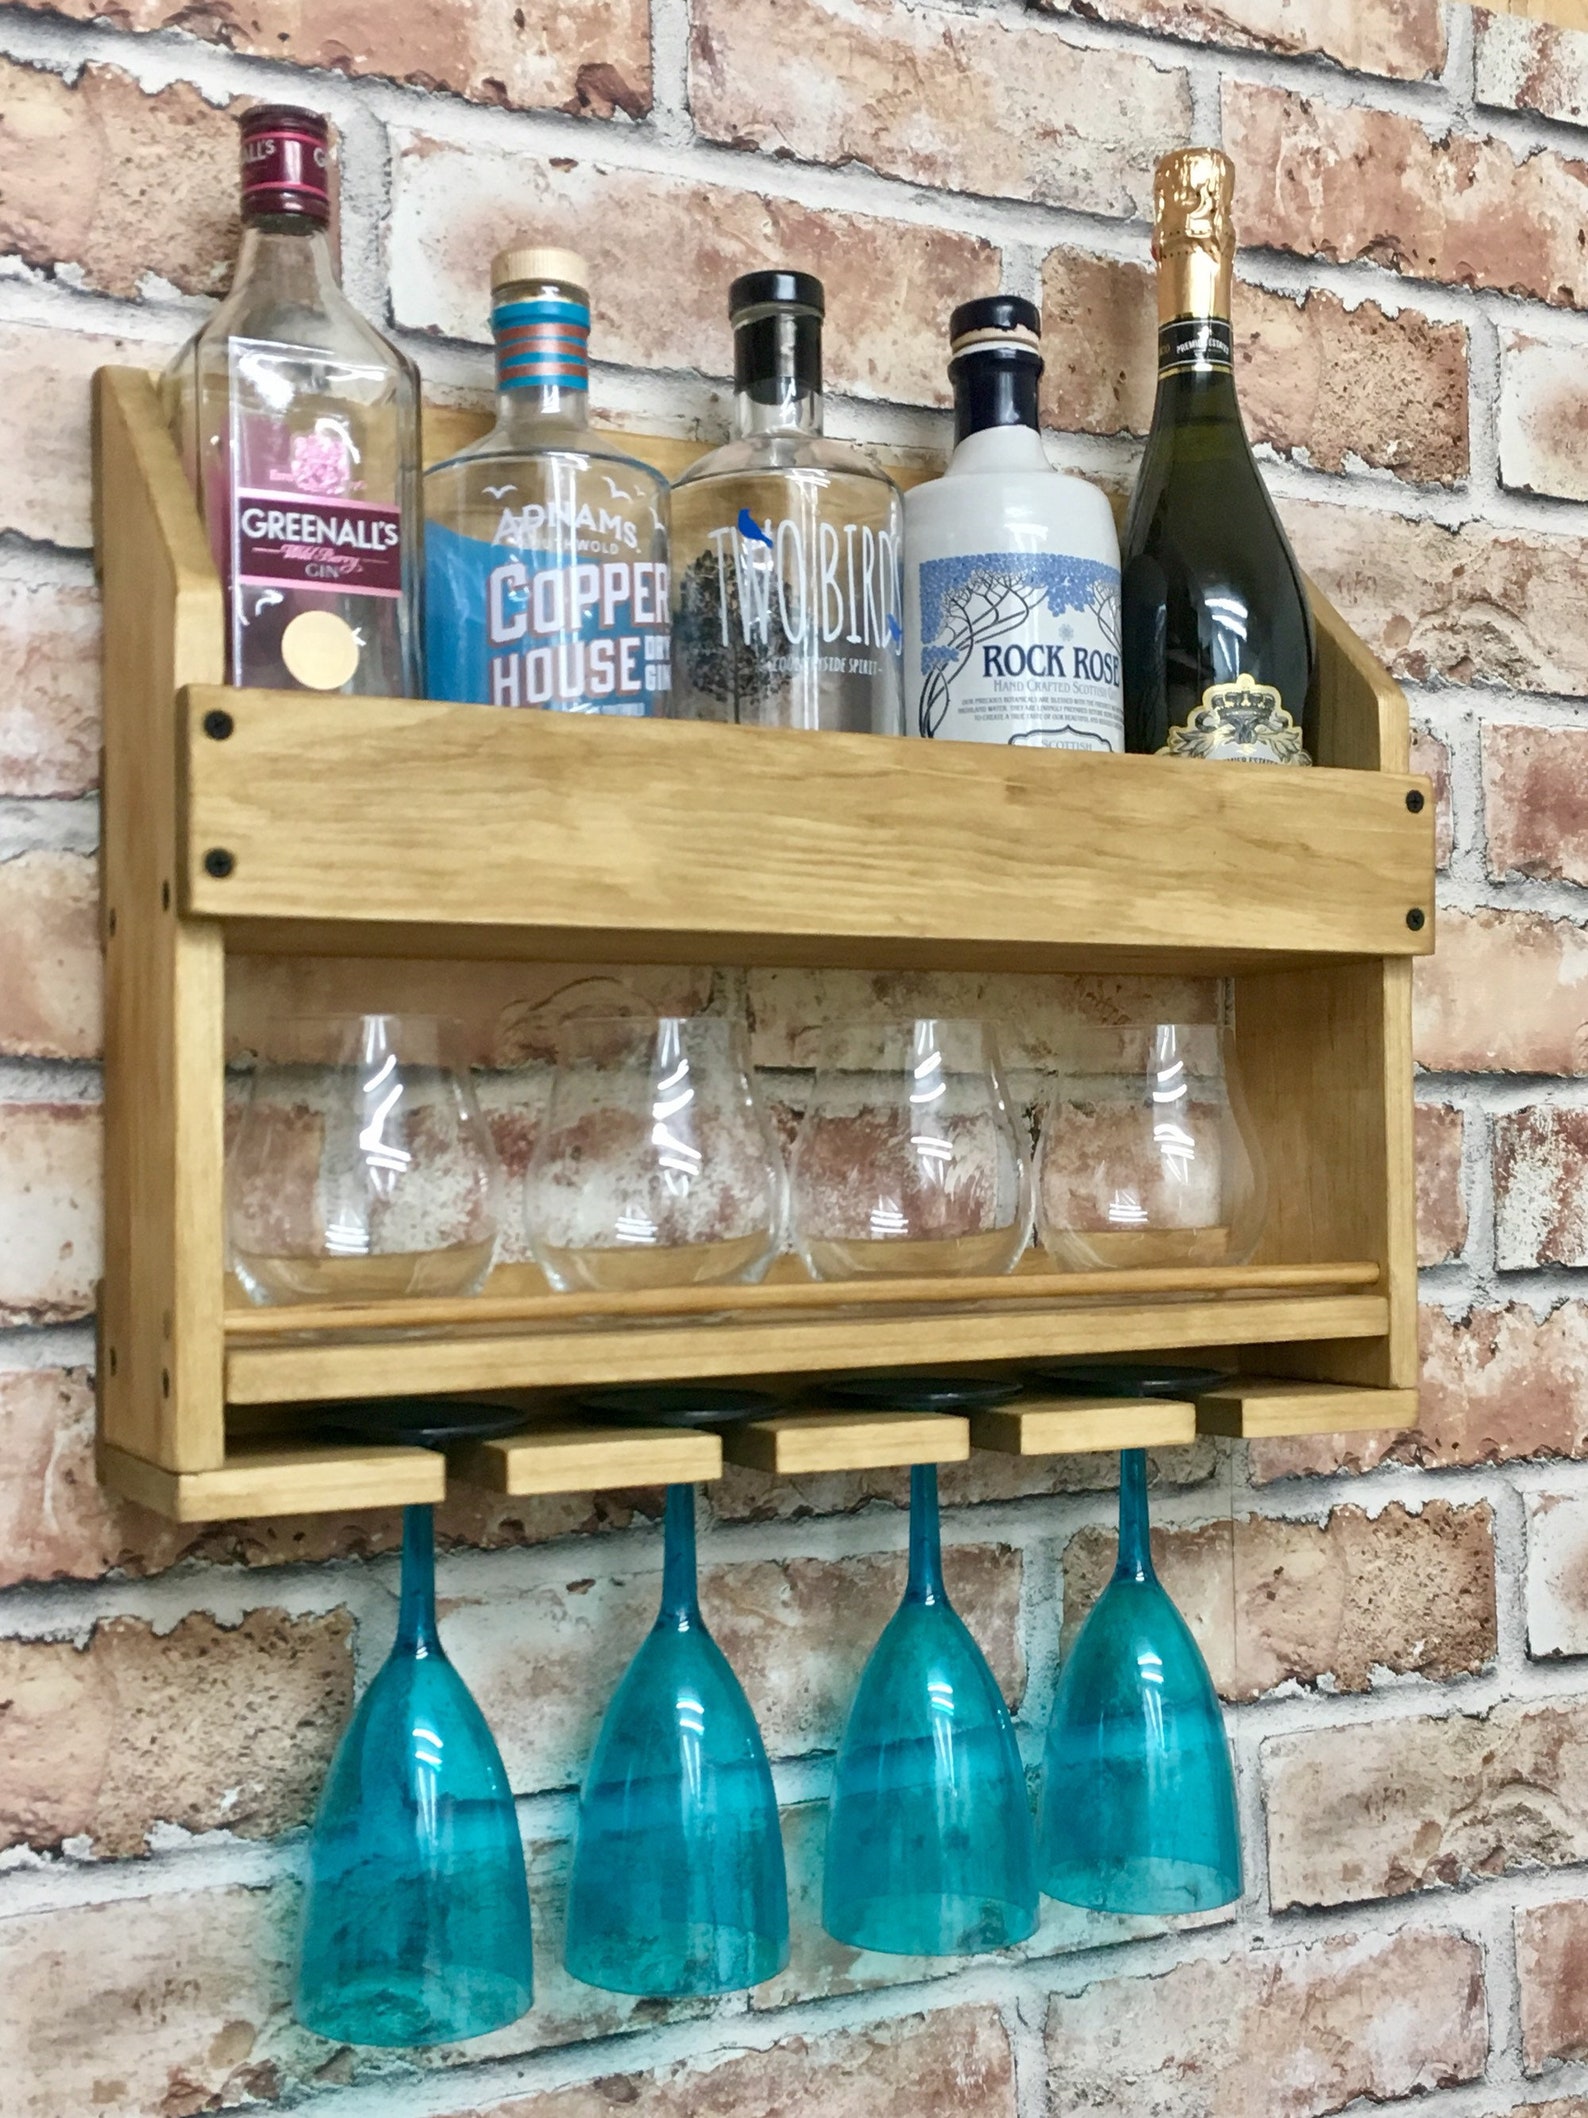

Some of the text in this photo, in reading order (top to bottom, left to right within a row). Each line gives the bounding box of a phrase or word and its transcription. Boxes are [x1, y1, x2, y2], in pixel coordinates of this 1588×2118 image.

[241, 507, 399, 550] GREENALL'S
[305, 562, 340, 578] GIN
[707, 519, 807, 647] TWO
[488, 562, 671, 645] COPPER
[491, 636, 642, 708] HOUSE
[982, 644, 1120, 687] ROCK ROSE
[994, 680, 1024, 693] HAND
[1026, 680, 1071, 694] CRAFTED
